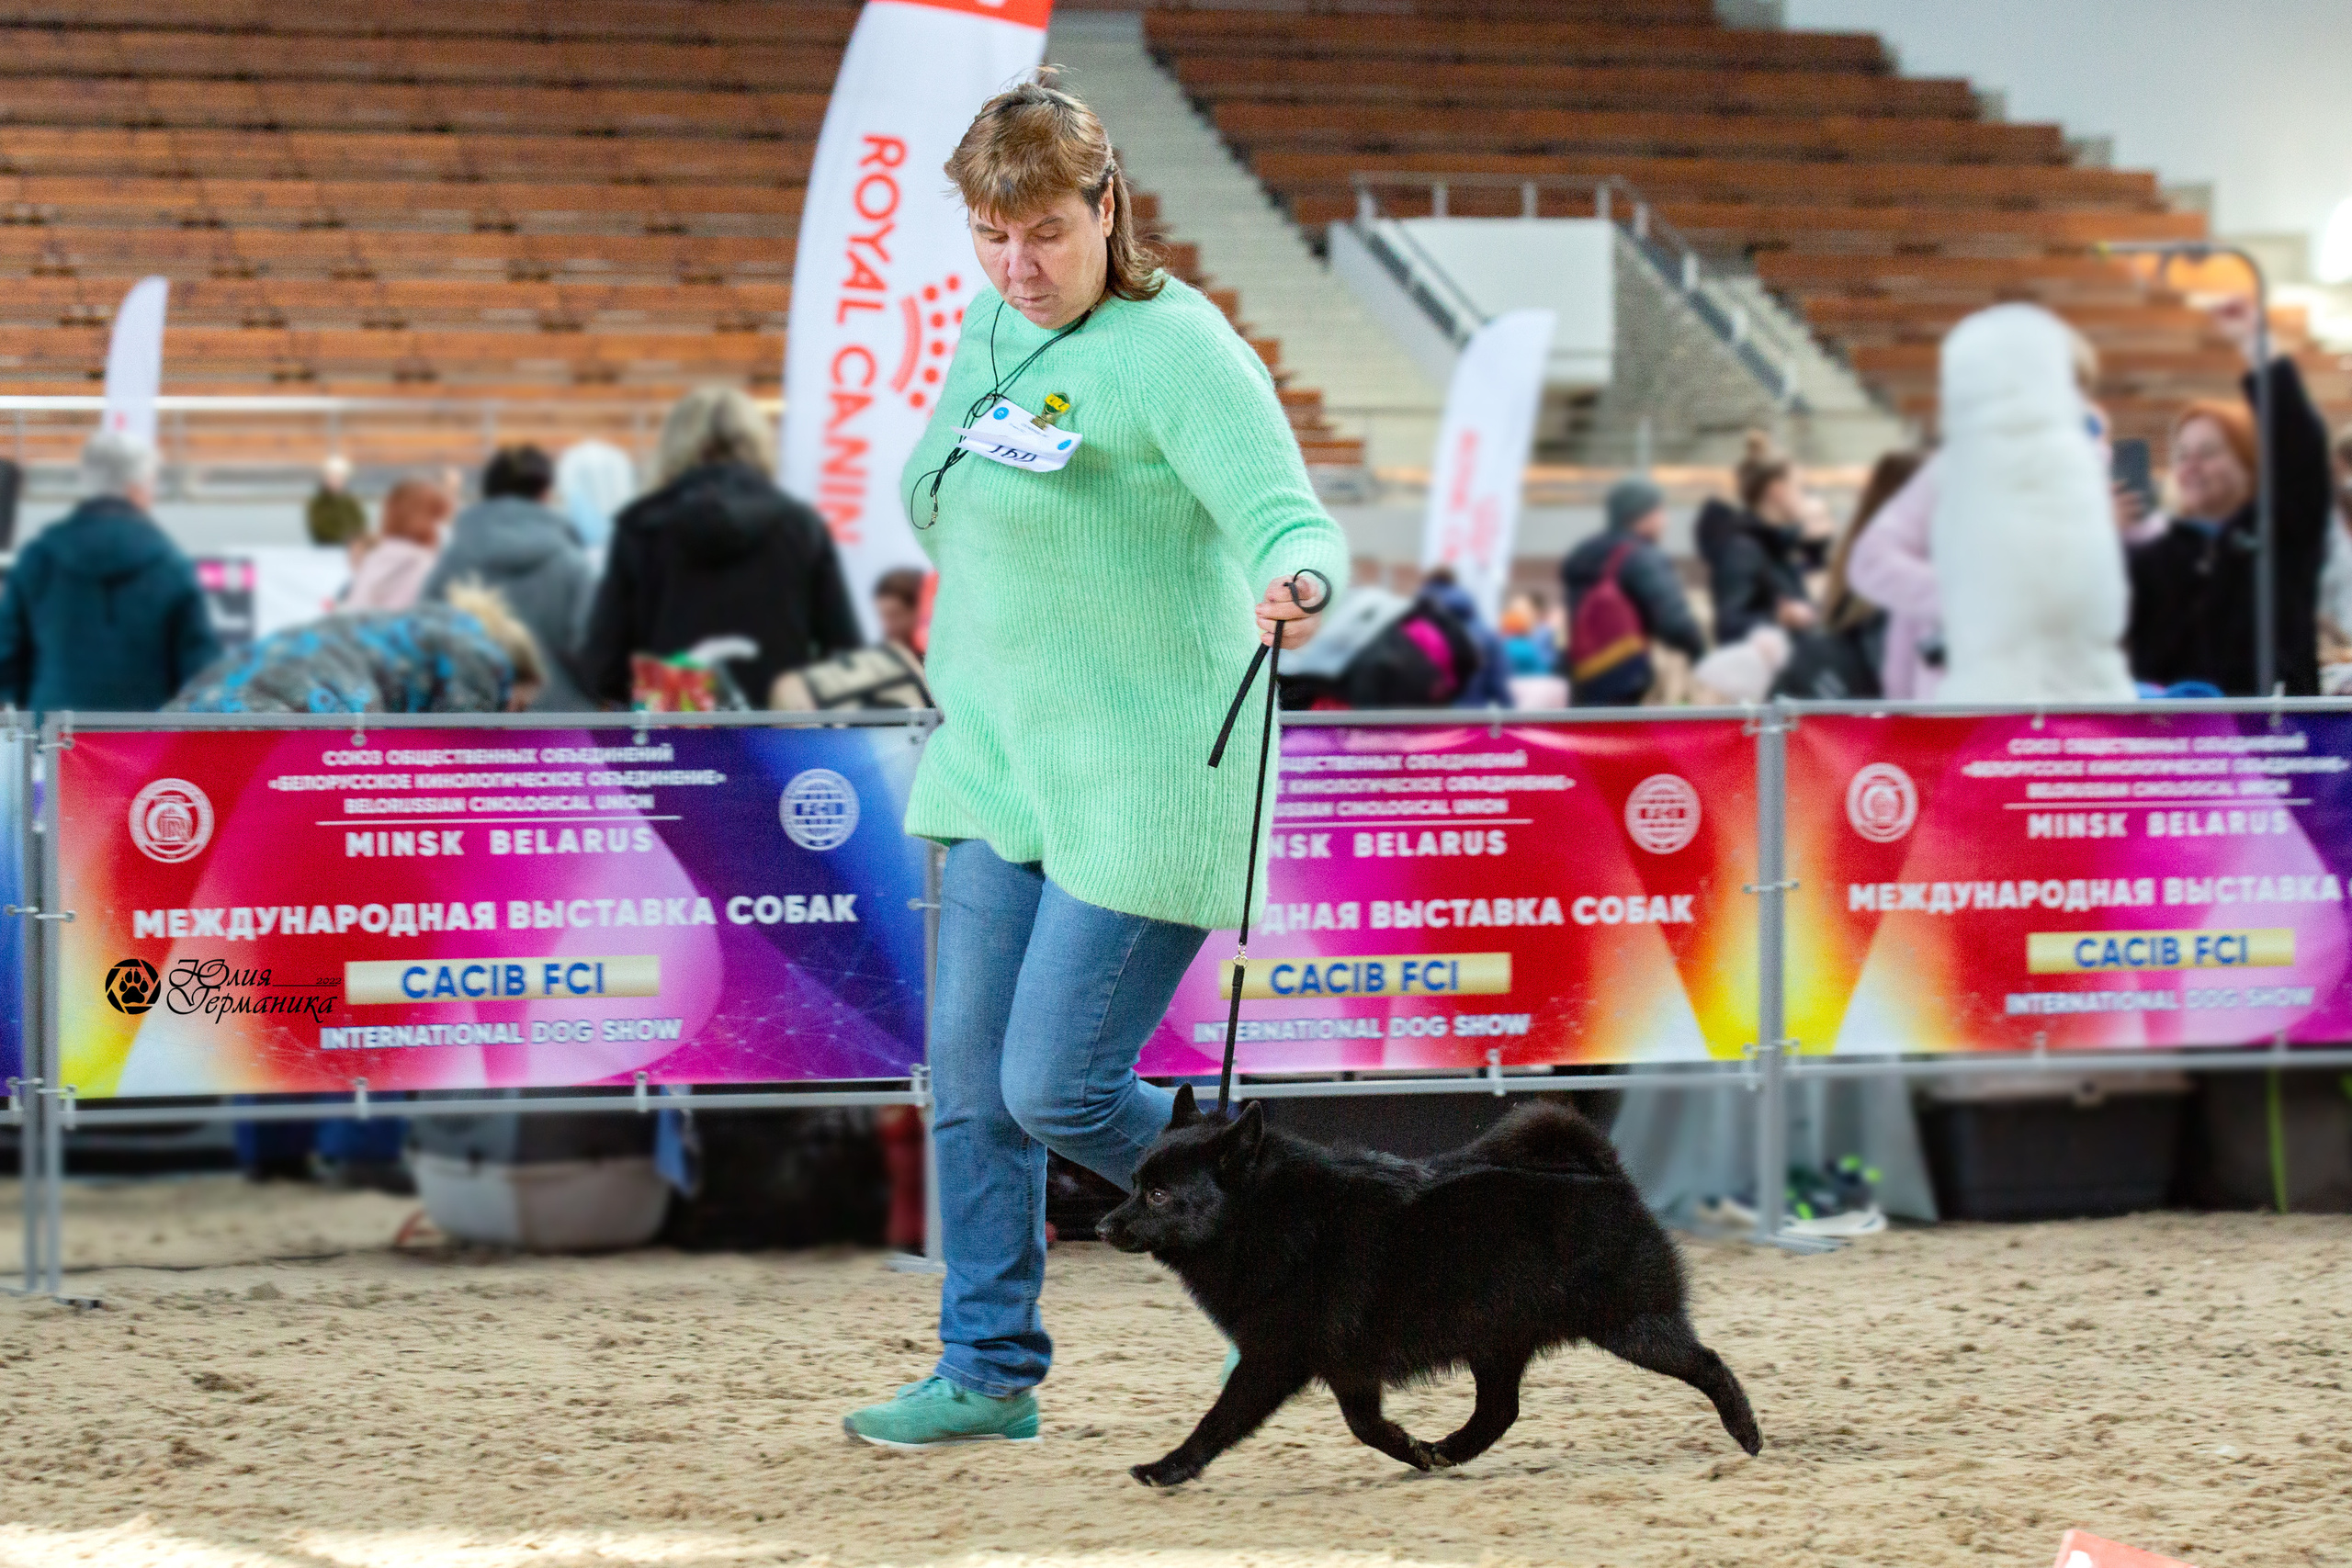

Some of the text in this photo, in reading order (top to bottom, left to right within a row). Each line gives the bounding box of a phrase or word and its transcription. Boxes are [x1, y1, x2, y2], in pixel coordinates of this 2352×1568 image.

[818, 134, 908, 545] ROYAL CANIN
[2027, 809, 2289, 840] MINSK BELARUS
[345, 828, 653, 858] MINSK BELARUS
[1268, 829, 1508, 859] NSK BELARUS
[1849, 877, 2155, 914] МЕЖДУНАРОДНАЯ
[2164, 874, 2343, 907] ВЫСТАВКА
[133, 893, 859, 941] МЕЖДУНАРОДНАЯ ВЫСТАВКА СОБАК
[1368, 897, 1564, 930] ВЫСТАВКА
[1571, 894, 1696, 925] СОБАК
[2074, 934, 2249, 967] CACIB FCI
[401, 962, 605, 998] CACIB FCI
[1270, 960, 1460, 995] CACIB FCI
[320, 1018, 684, 1050] INTERNATIONAL DOG SHOW
[1390, 1015, 1449, 1039] DOG
[1453, 1013, 1532, 1037] SHOW
